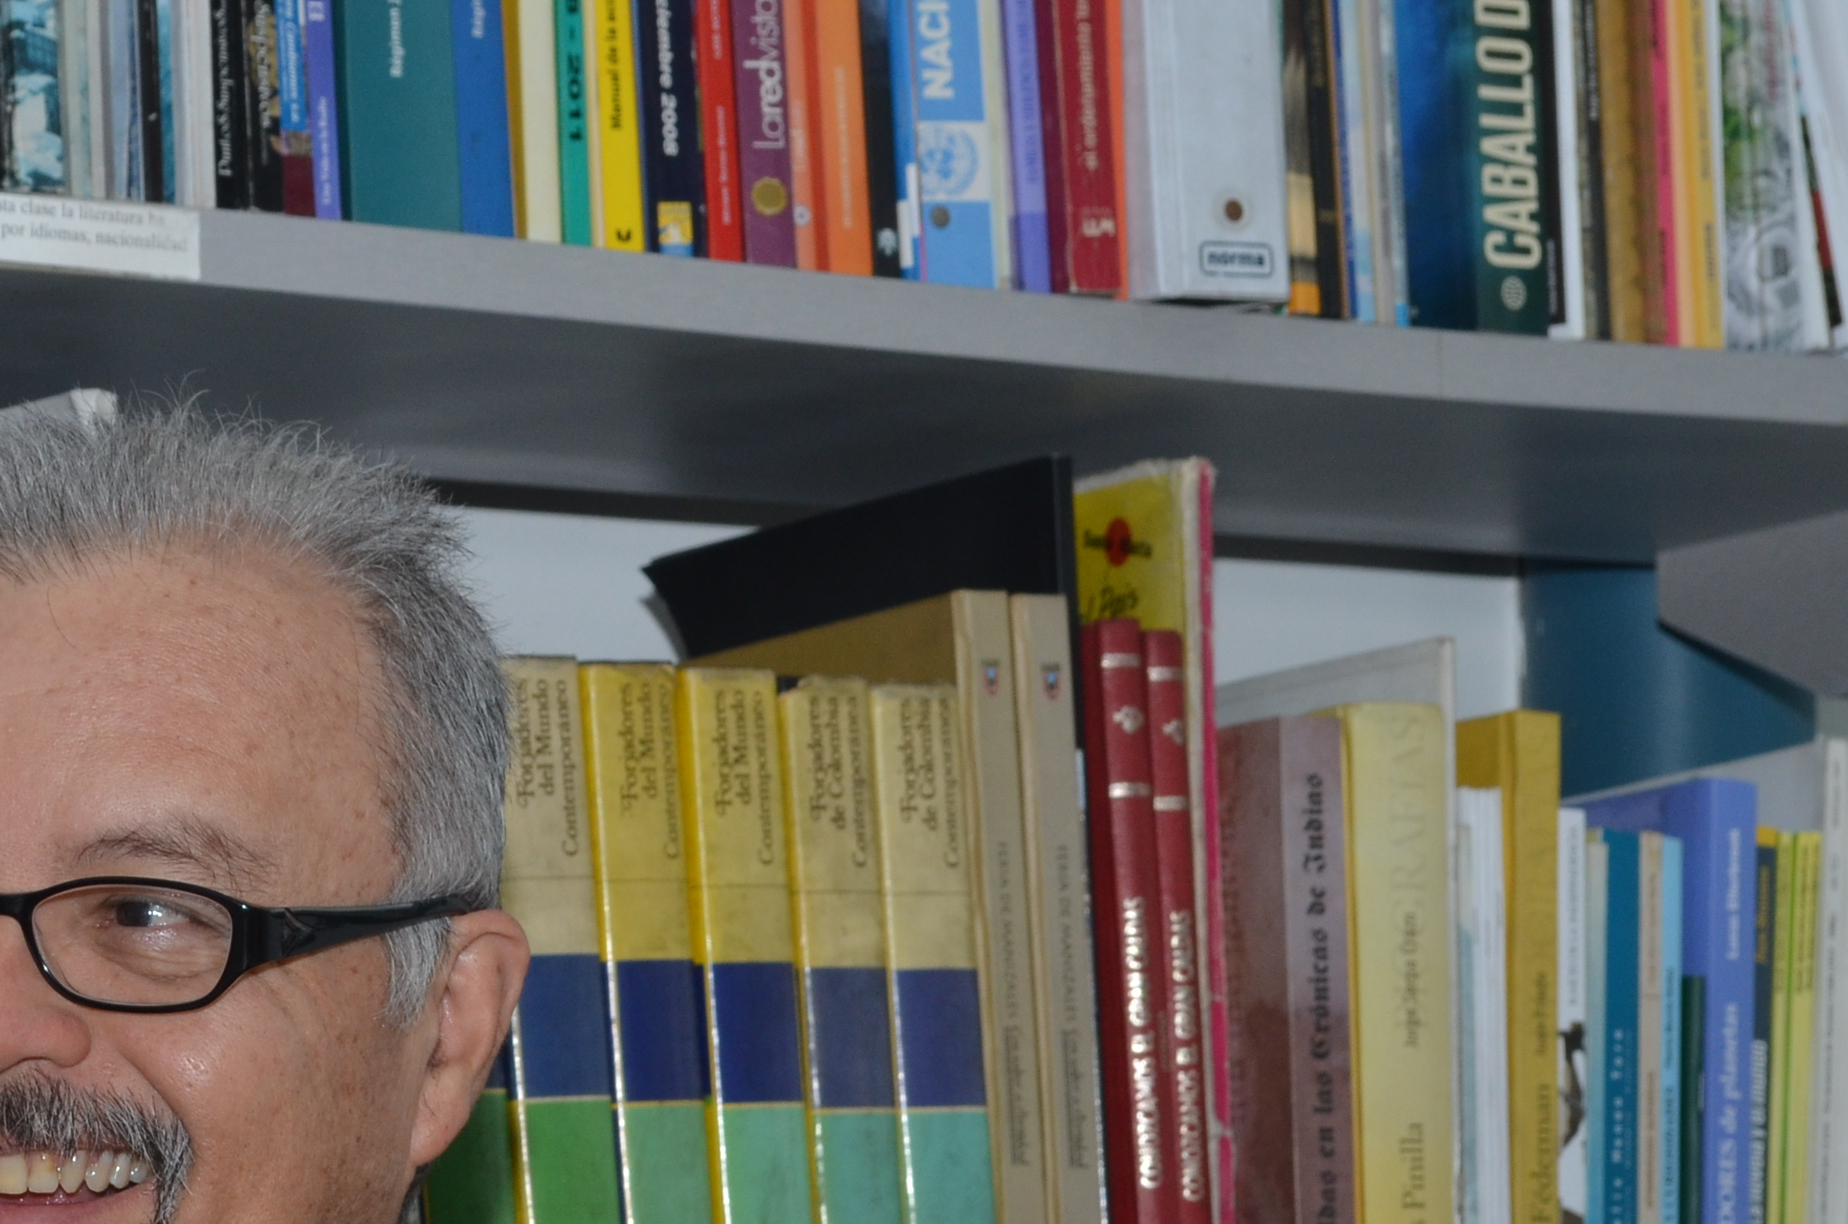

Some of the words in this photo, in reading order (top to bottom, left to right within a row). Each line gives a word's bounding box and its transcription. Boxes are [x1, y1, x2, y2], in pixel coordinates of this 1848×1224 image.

[567, 52, 583, 142] 2011
[660, 93, 678, 157] 2008
[1474, 35, 1543, 270] CABALLO
[20, 198, 57, 218] clase
[61, 202, 75, 219] la
[79, 203, 143, 225] literatura
[1208, 250, 1265, 266] norma
[512, 678, 536, 809] Forjadores
[530, 679, 554, 756] Mundo
[730, 689, 750, 765] Mundo
[536, 763, 555, 796] del
[553, 679, 581, 857] Contemporáneo
[734, 773, 751, 805] del
[1300, 772, 1327, 874] Indias
[1000, 893, 1013, 913] DE
[1122, 896, 1147, 969] CALDAS
[1307, 885, 1328, 917] de
[1000, 918, 1019, 1018] MANIZALES
[1126, 971, 1150, 1028] GRAN
[1304, 927, 1334, 1062] Crónicas
[1130, 1032, 1155, 1053] EL
[1718, 1002, 1744, 1100] planetas
[1311, 1071, 1335, 1116] las
[1716, 1105, 1739, 1133] de
[1316, 1126, 1337, 1159] en
[1400, 1122, 1428, 1211] Pinilla
